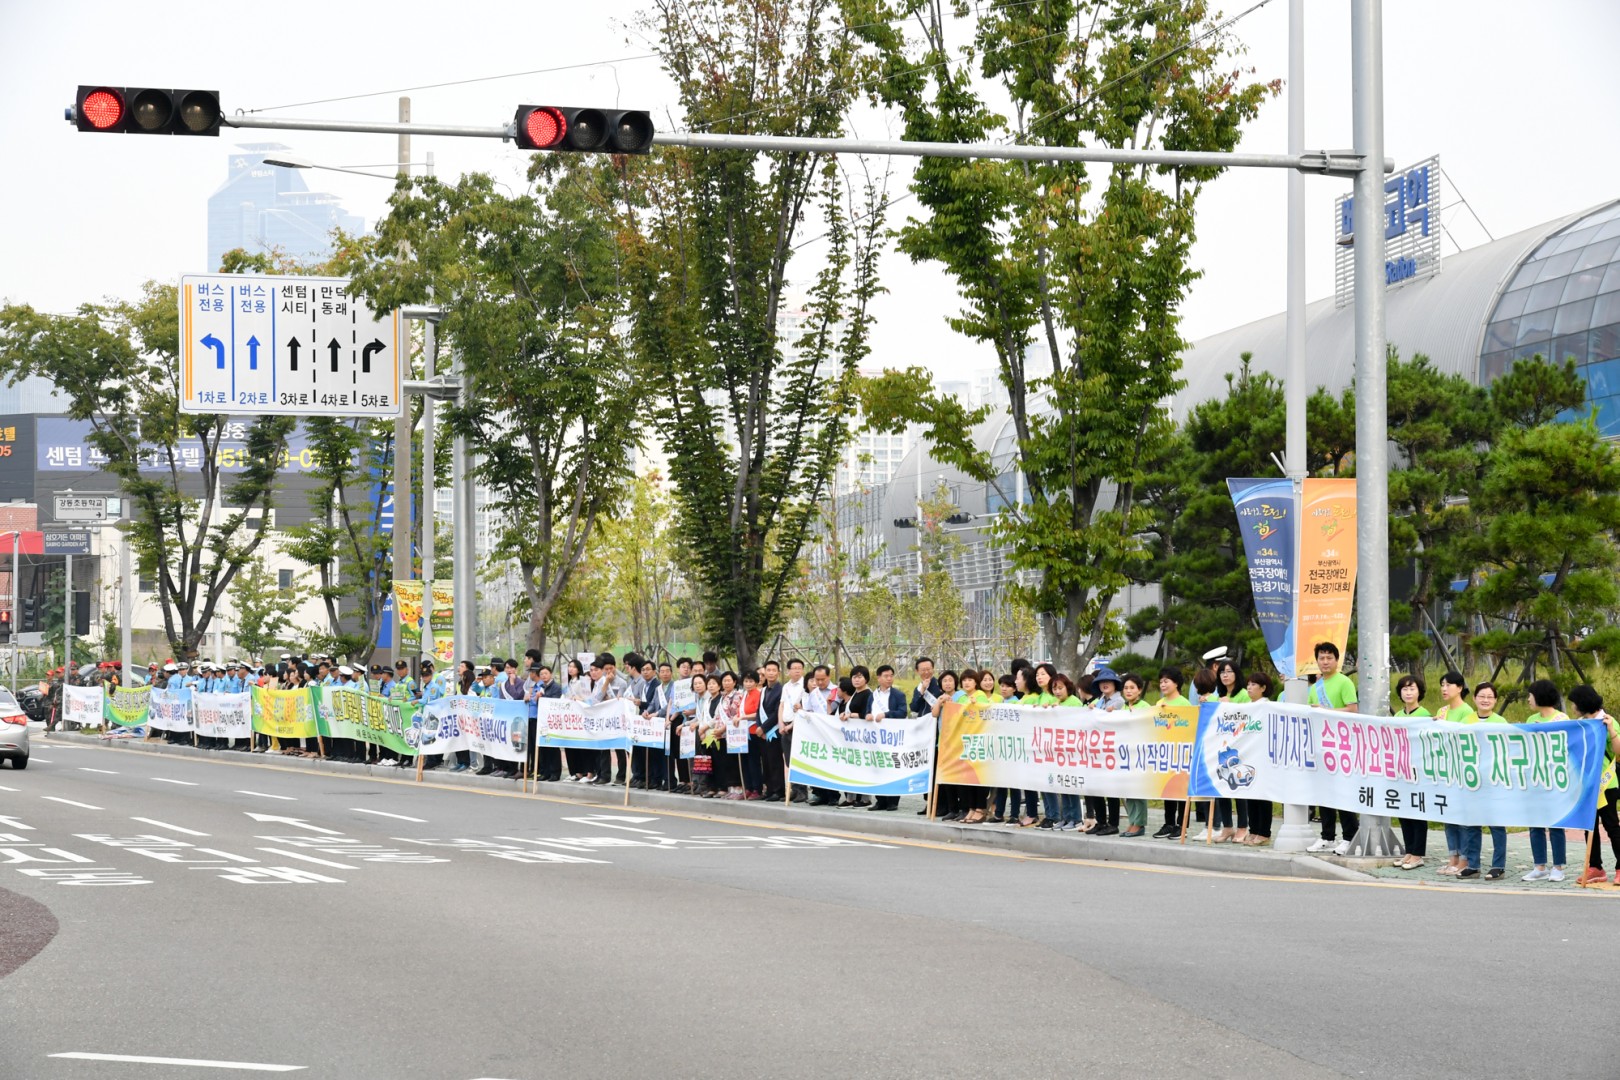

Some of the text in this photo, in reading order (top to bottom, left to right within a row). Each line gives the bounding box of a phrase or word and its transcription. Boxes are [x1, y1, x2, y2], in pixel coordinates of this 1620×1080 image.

[197, 283, 224, 296] 버스
[239, 285, 266, 298] 버스
[281, 285, 307, 299] 센텀
[199, 298, 225, 312] 전용
[240, 300, 266, 314] 전용
[281, 301, 307, 314] 시티
[321, 302, 347, 315] 동래
[197, 390, 227, 404] 1차로
[239, 391, 269, 405] 2차로
[280, 392, 309, 406] 3차로
[320, 393, 349, 407] 4차로
[361, 394, 390, 408] 5차로
[45, 446, 82, 467] 센텀
[59, 499, 103, 507] 강동초등학교
[45, 533, 88, 541] 삼호가든 아파트
[1254, 558, 1283, 566] 부산광역시
[1248, 567, 1288, 580] 전국장애인
[1308, 568, 1348, 581] 전국장애인
[1303, 582, 1351, 595] 기능경기대회
[1223, 711, 1249, 720] Sun&Fun
[880, 728, 905, 747] Day!!
[799, 740, 829, 761] 저탄소
[960, 735, 995, 760] 교통질서
[1268, 713, 1568, 789] 내가지킨 승용차요일제, 나라사랑 지구사랑
[1057, 774, 1085, 788] 해운대구
